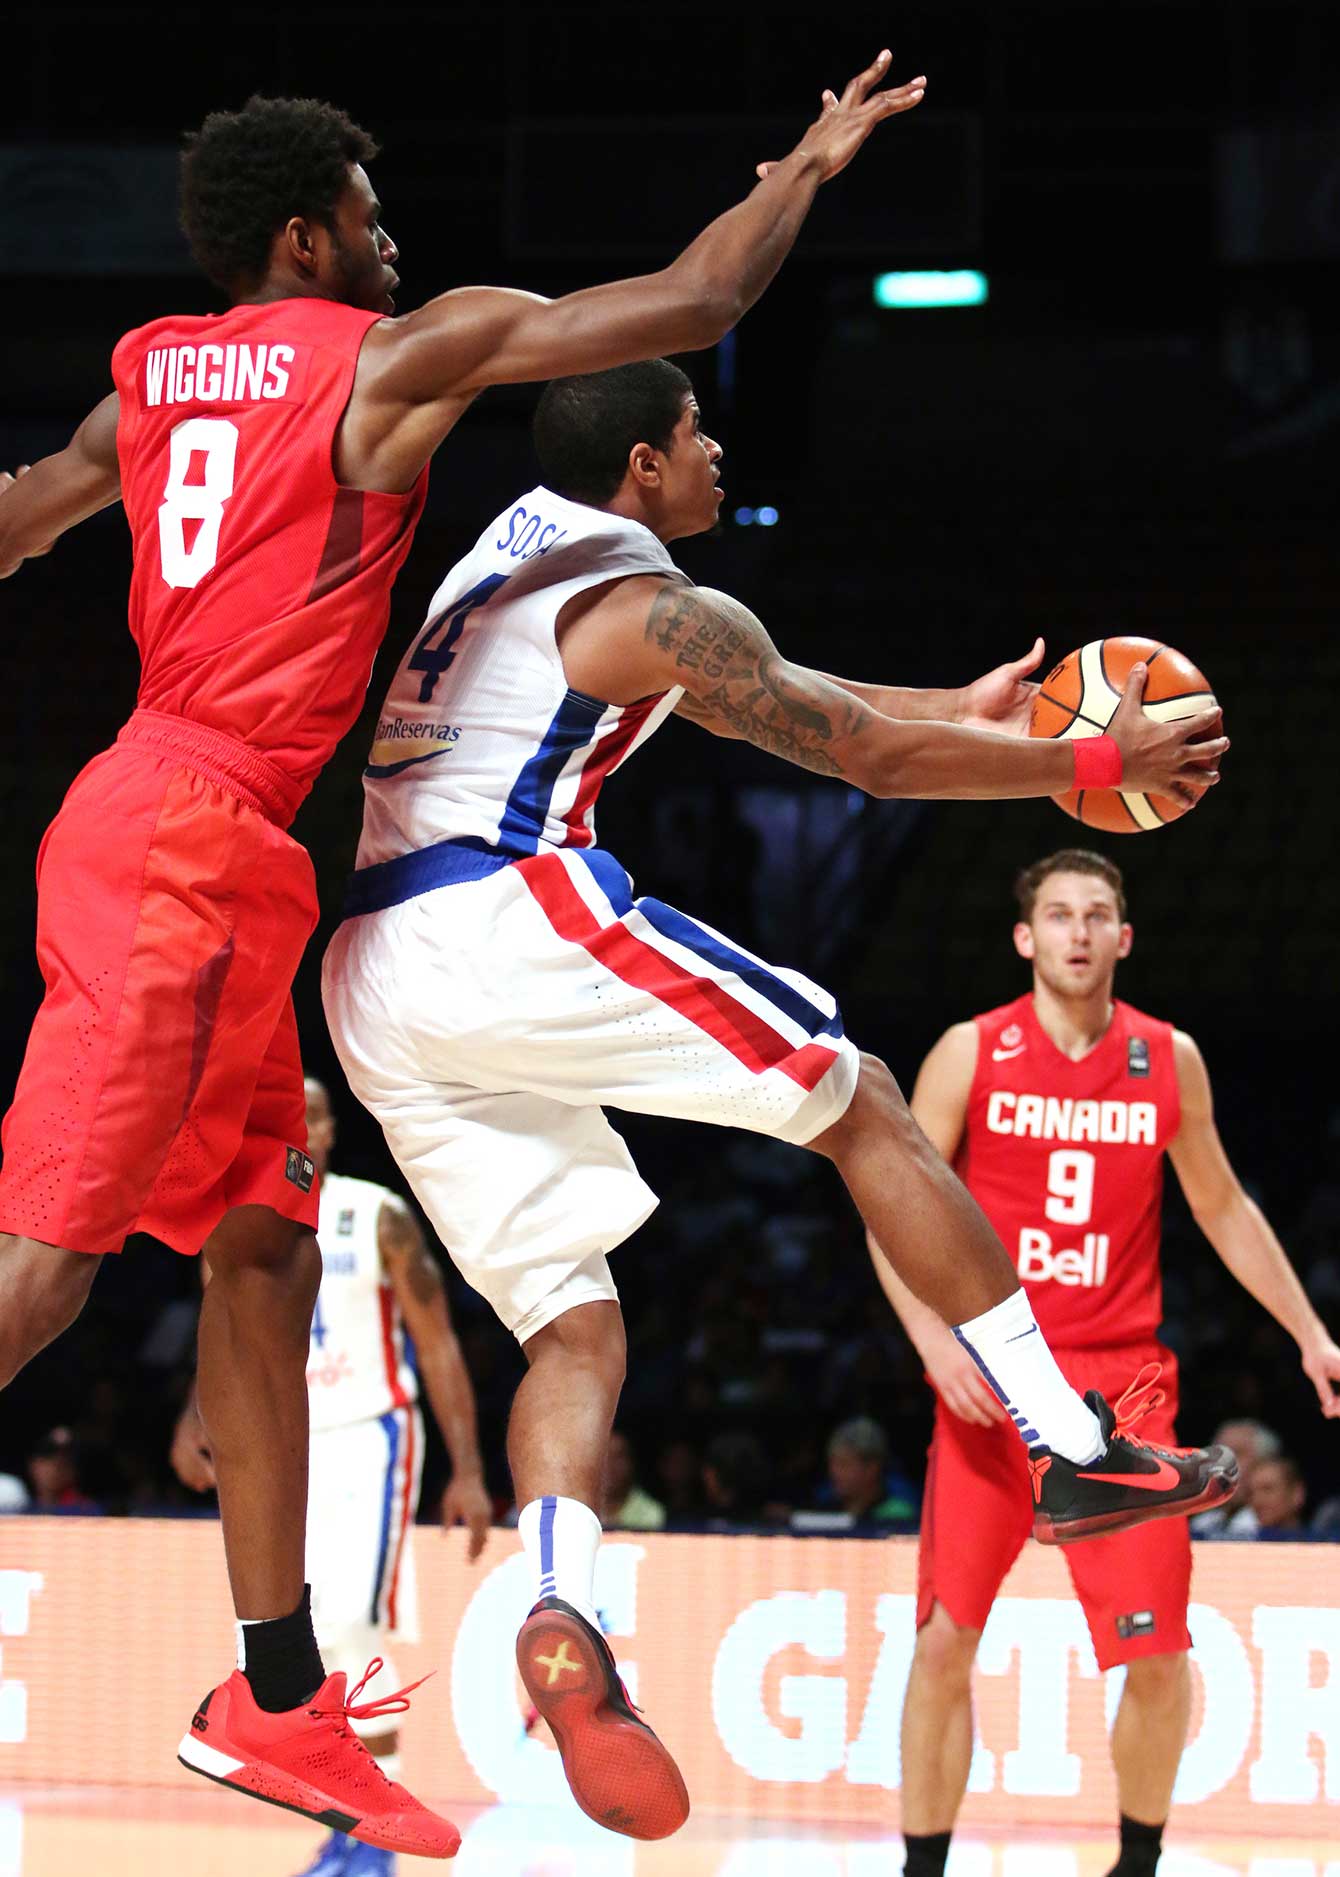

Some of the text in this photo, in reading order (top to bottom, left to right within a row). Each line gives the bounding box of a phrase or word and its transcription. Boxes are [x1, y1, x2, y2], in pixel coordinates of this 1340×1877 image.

[146, 344, 296, 407] WIGGINS
[158, 418, 239, 590] 8
[407, 572, 512, 704] 4
[986, 1091, 1158, 1146] CANADA
[1044, 1148, 1096, 1226] 9
[1016, 1227, 1110, 1288] Bell
